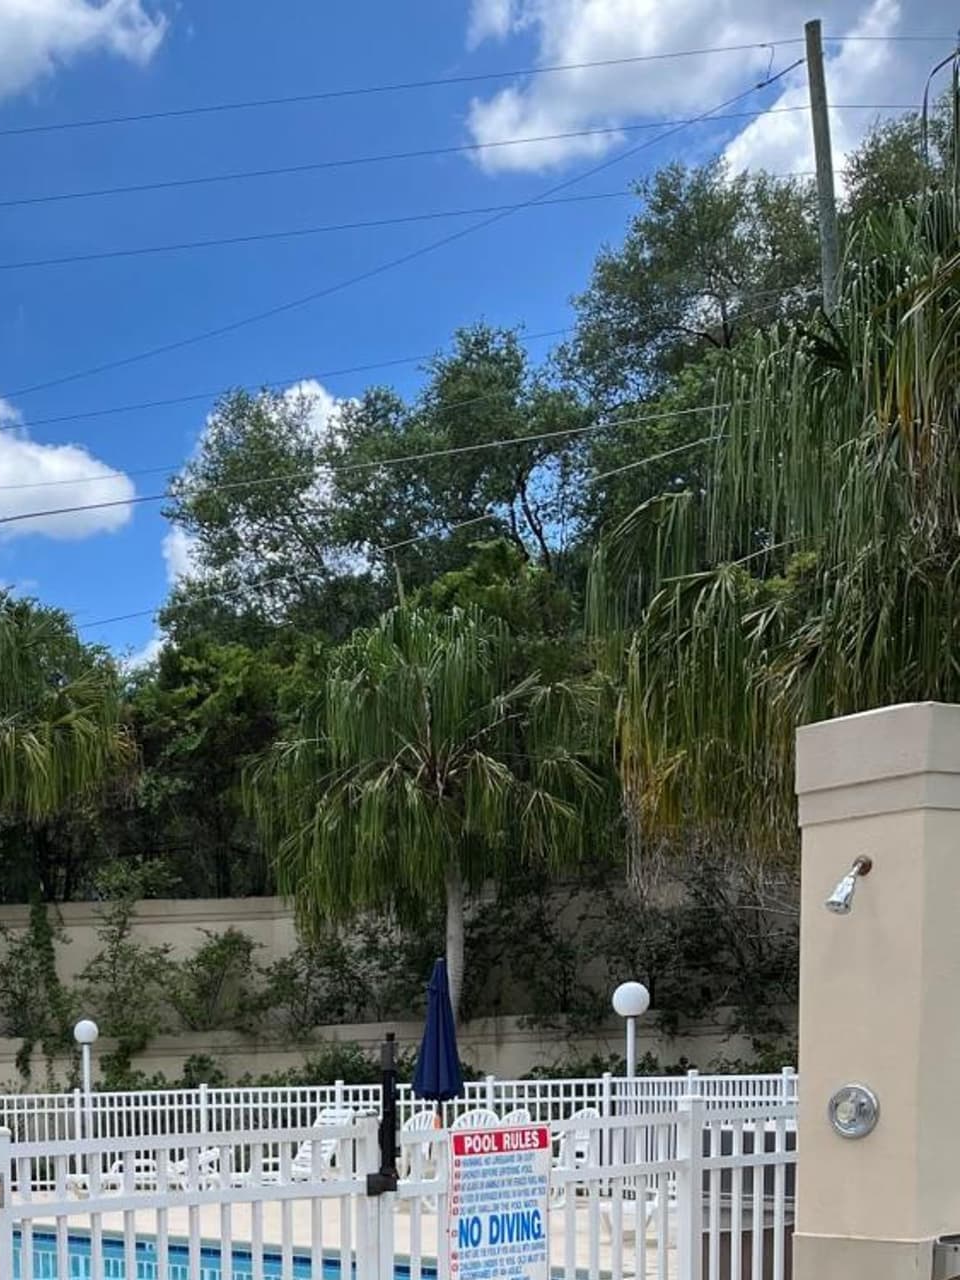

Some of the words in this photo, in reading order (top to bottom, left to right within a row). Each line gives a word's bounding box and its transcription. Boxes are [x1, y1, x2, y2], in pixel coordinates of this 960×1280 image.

[464, 1134, 498, 1153] POOL
[502, 1130, 539, 1150] RULES
[458, 1215, 482, 1248] NO
